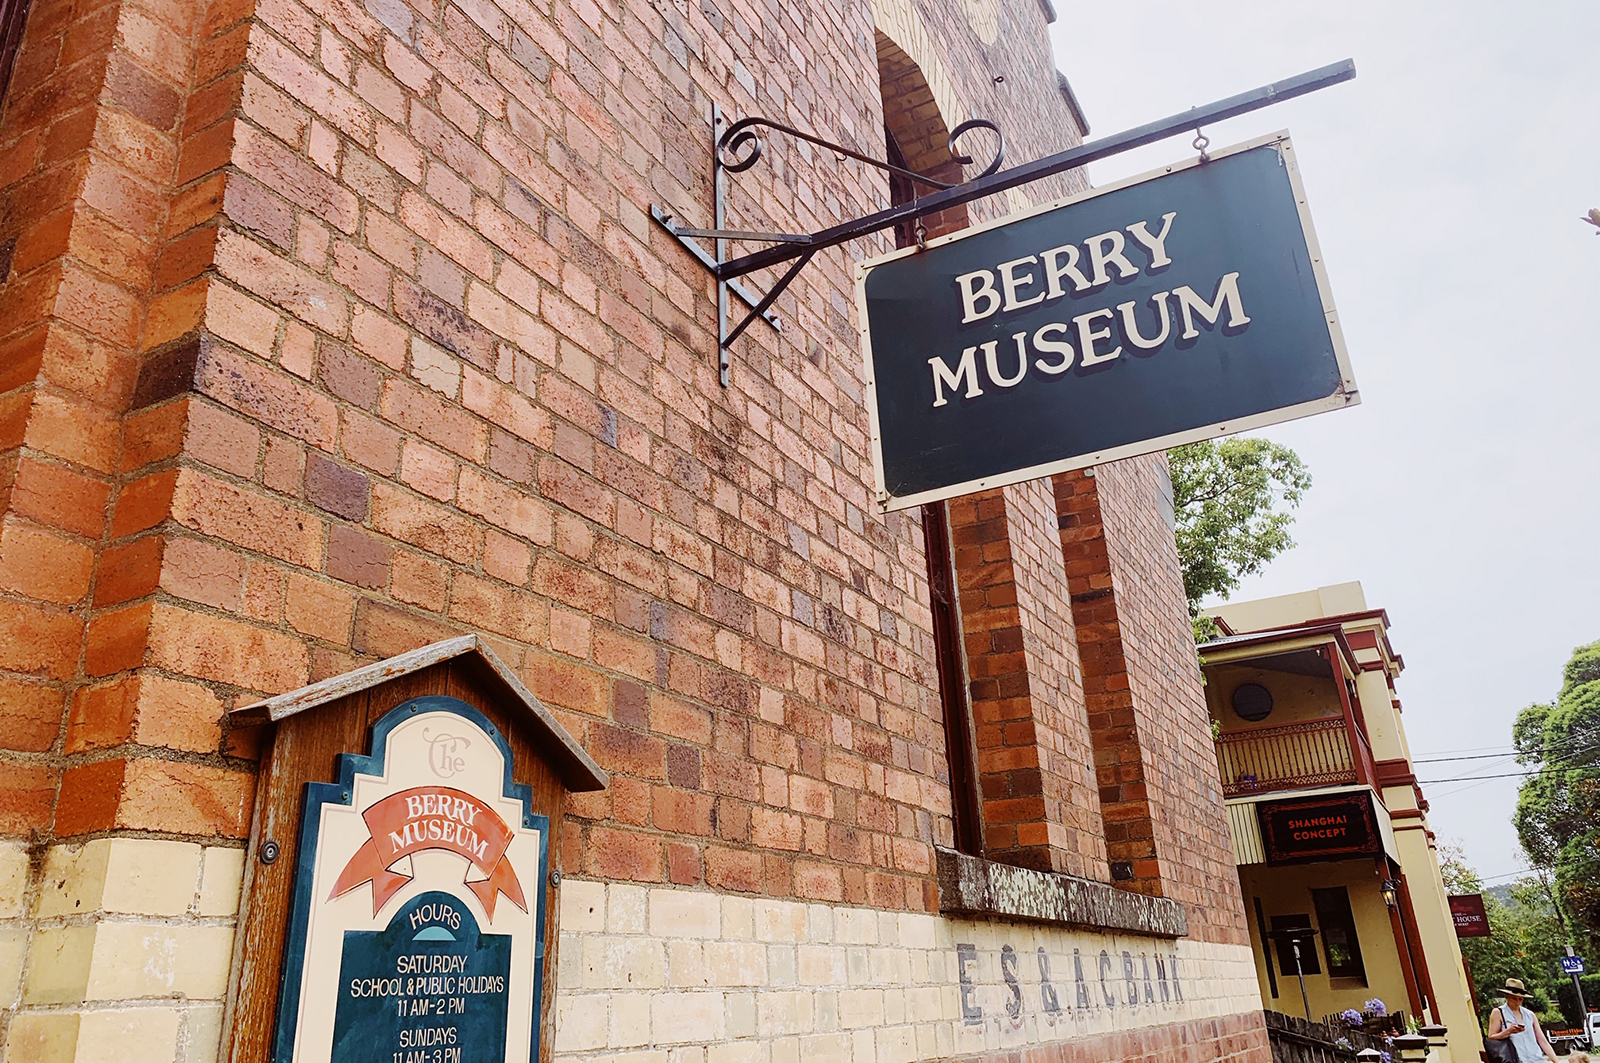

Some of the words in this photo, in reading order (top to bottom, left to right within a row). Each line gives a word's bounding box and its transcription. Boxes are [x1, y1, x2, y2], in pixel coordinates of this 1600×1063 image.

[955, 211, 1177, 324] BERRY
[927, 271, 1251, 408] MUSEUM
[422, 727, 471, 779] The
[405, 794, 482, 827] BERRY
[1288, 815, 1347, 829] SHANGHAI
[388, 819, 489, 861] MUSEUM
[1293, 827, 1346, 841] CONCEPT
[409, 903, 461, 930] HOURS
[396, 955, 468, 974] SATURDAY
[350, 978, 404, 998] SCHOOL
[406, 977, 414, 996] &
[416, 977, 456, 996] PUBLIC
[458, 976, 504, 994] HOLIDAYS
[399, 1026, 457, 1048] SUNDAYS
